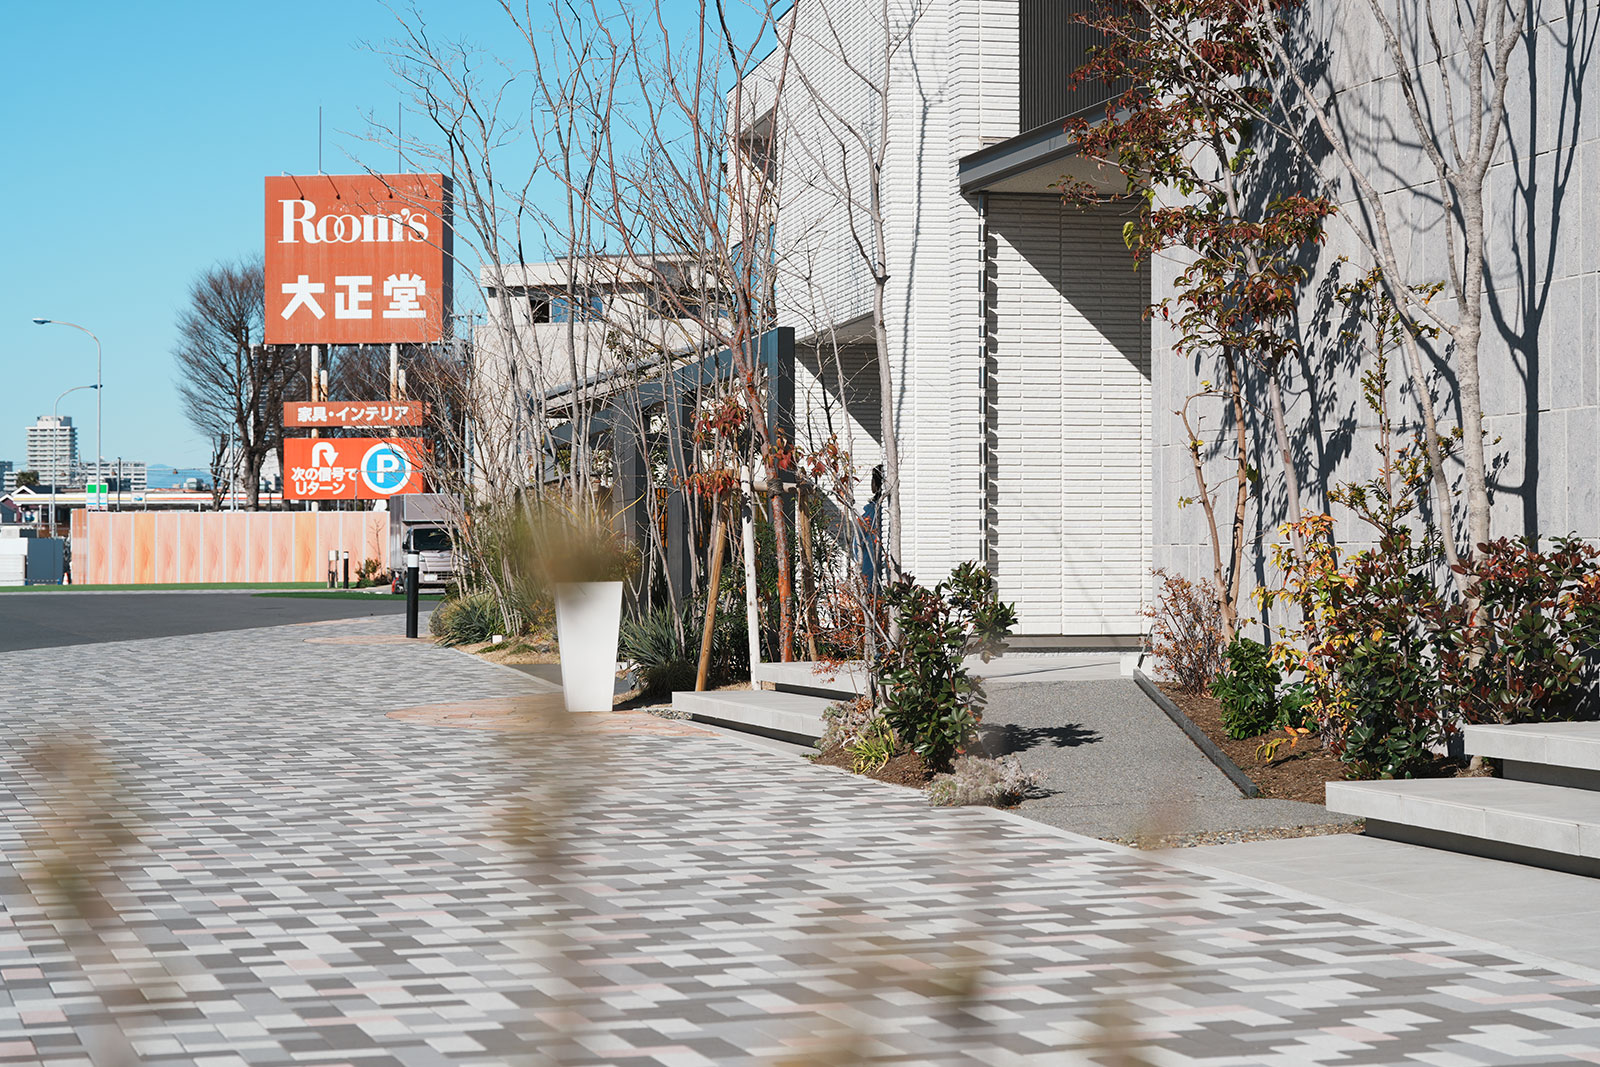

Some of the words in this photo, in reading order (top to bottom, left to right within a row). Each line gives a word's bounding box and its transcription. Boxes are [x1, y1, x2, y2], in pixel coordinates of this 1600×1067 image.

[278, 199, 429, 244] Room's
[280, 273, 427, 320] 大正堂
[297, 406, 409, 422] 家具・インテリア
[291, 467, 358, 482] 次の信号で
[377, 454, 400, 484] P
[295, 482, 346, 495] Uターン
